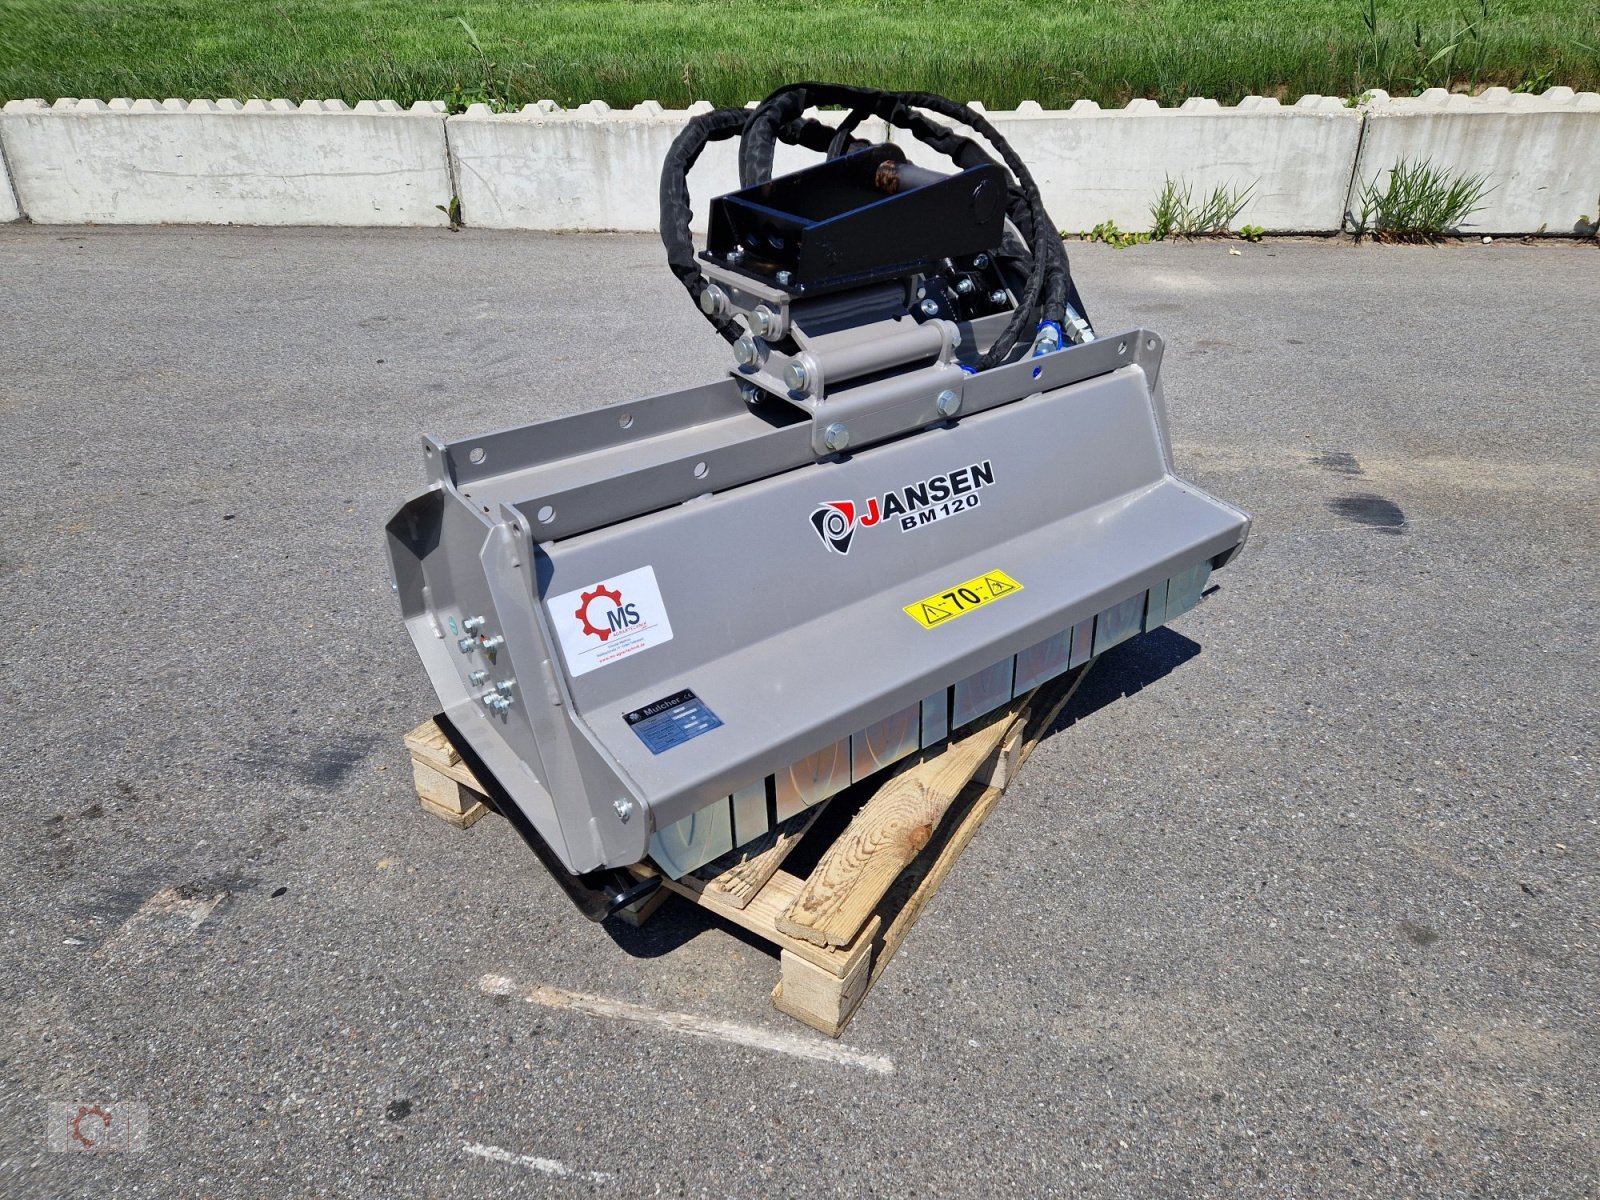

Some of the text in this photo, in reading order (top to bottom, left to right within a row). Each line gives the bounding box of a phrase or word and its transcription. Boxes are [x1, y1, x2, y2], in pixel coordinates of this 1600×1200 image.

[859, 460, 995, 527] JANSEN
[942, 587, 981, 610] 70
[643, 697, 680, 716] Mulcher
